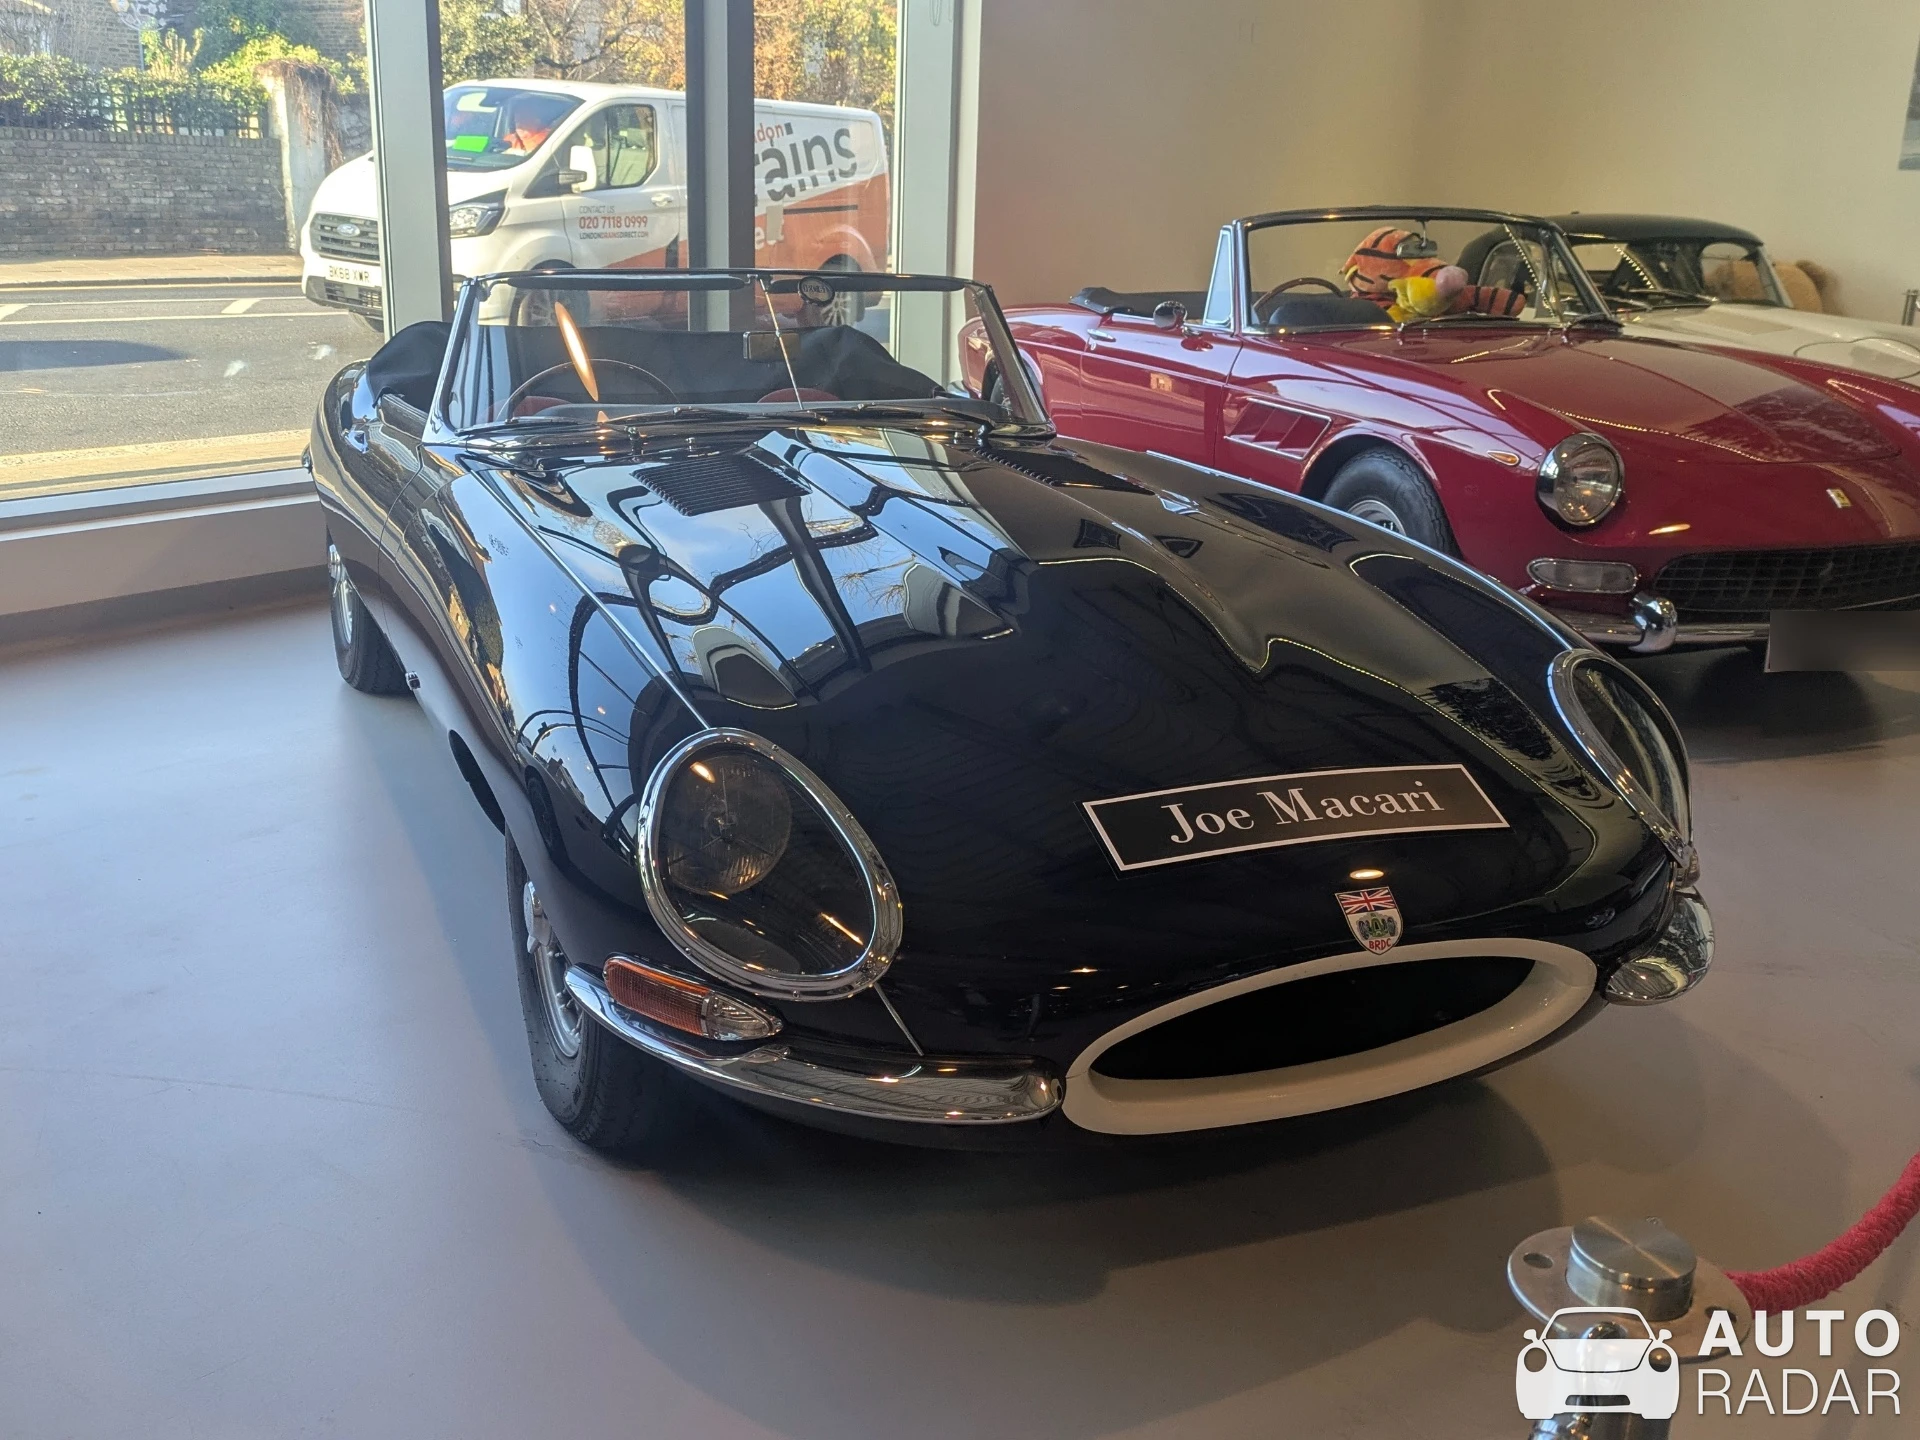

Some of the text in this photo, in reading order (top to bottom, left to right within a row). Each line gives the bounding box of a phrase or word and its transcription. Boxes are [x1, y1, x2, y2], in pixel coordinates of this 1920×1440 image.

[754, 122, 785, 143] don
[578, 205, 615, 214] CONTACT US
[579, 215, 648, 229] 020 7118 0999
[1161, 780, 1446, 844] Joe Macari
[1368, 938, 1392, 951] BRDC
